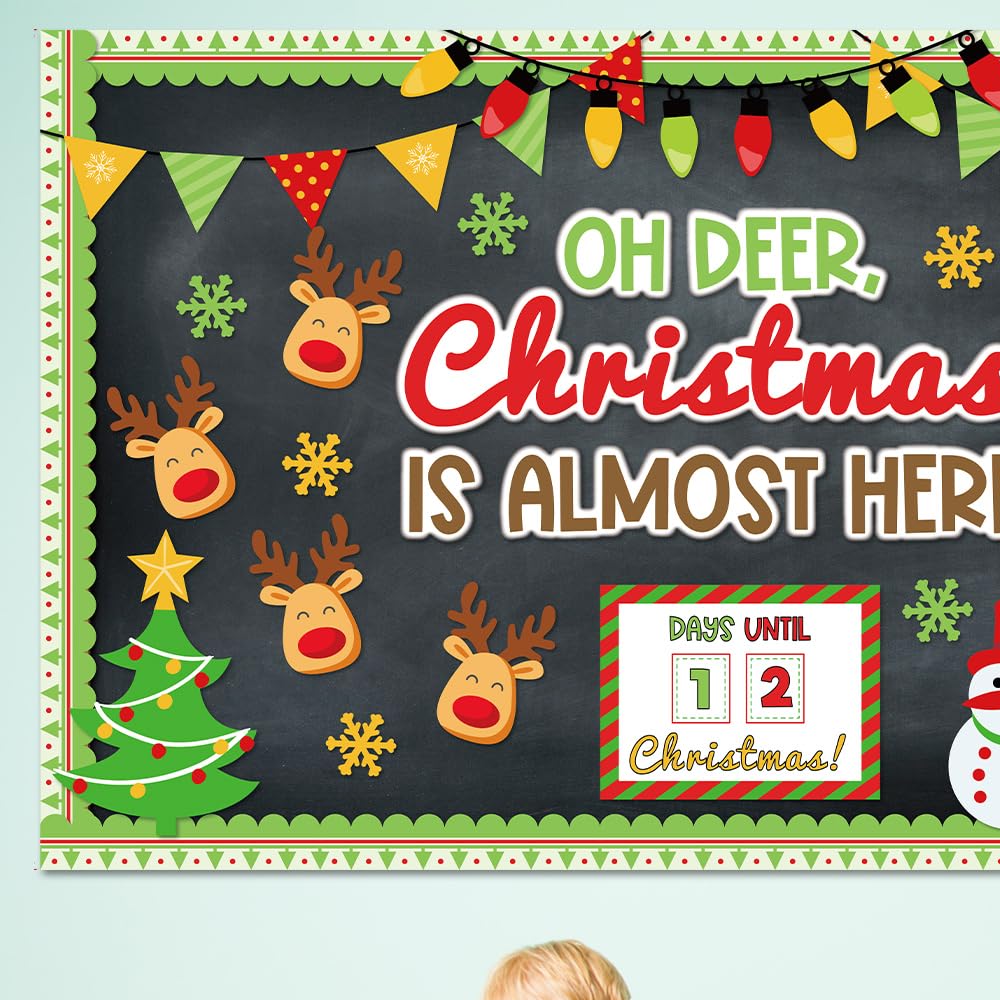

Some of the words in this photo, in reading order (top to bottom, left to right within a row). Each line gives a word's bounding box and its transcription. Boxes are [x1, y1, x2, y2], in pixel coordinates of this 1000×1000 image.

[563, 216, 665, 292] OH
[695, 216, 882, 295] DEER,
[408, 454, 476, 534] IS
[508, 453, 820, 534] ALMOST
[669, 615, 735, 642] DAYS
[744, 616, 811, 642] UNTIL
[689, 668, 710, 710] 1
[760, 665, 793, 708] 2
[629, 732, 847, 775] Christmas!
